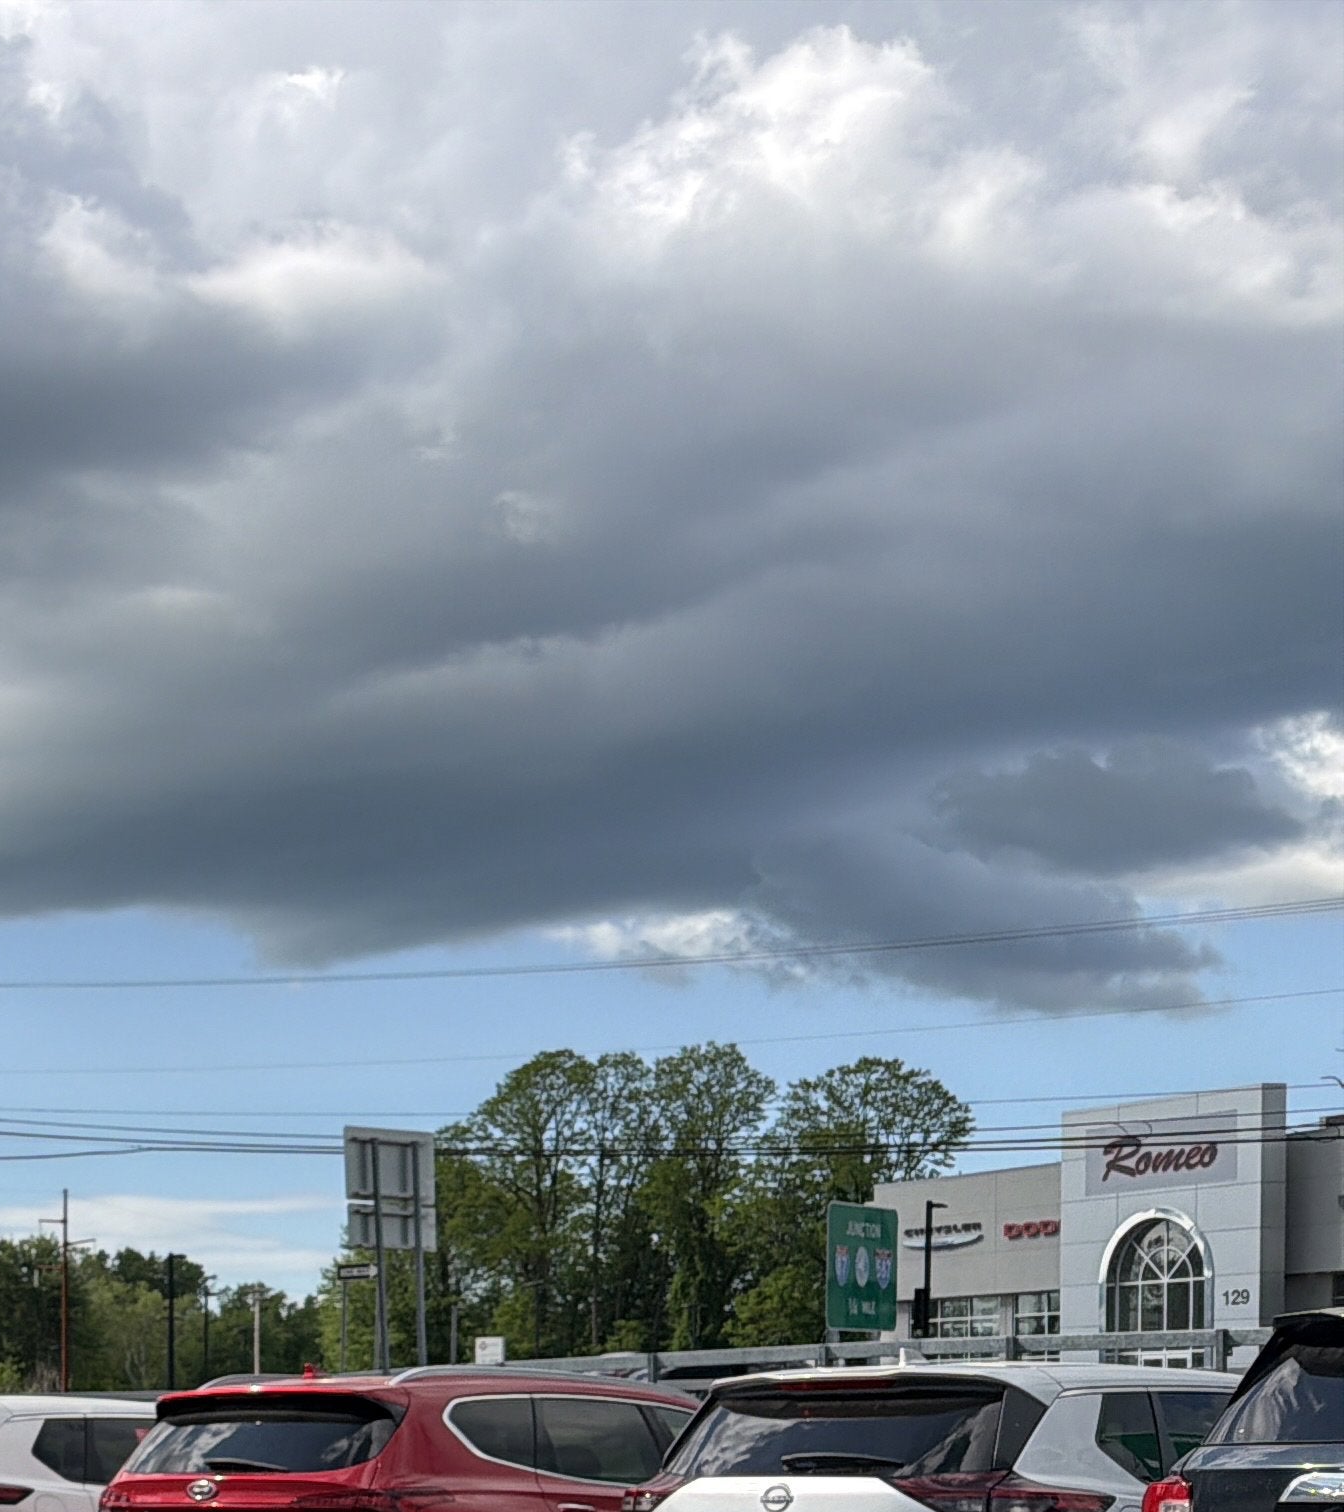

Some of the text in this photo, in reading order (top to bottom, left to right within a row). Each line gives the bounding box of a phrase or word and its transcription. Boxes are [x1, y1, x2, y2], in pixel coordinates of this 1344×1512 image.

[1101, 1136, 1219, 1182] Romeo
[904, 1222, 982, 1238] CHYSLER
[1003, 1219, 1061, 1240] DOD
[1222, 1289, 1250, 1306] 129
